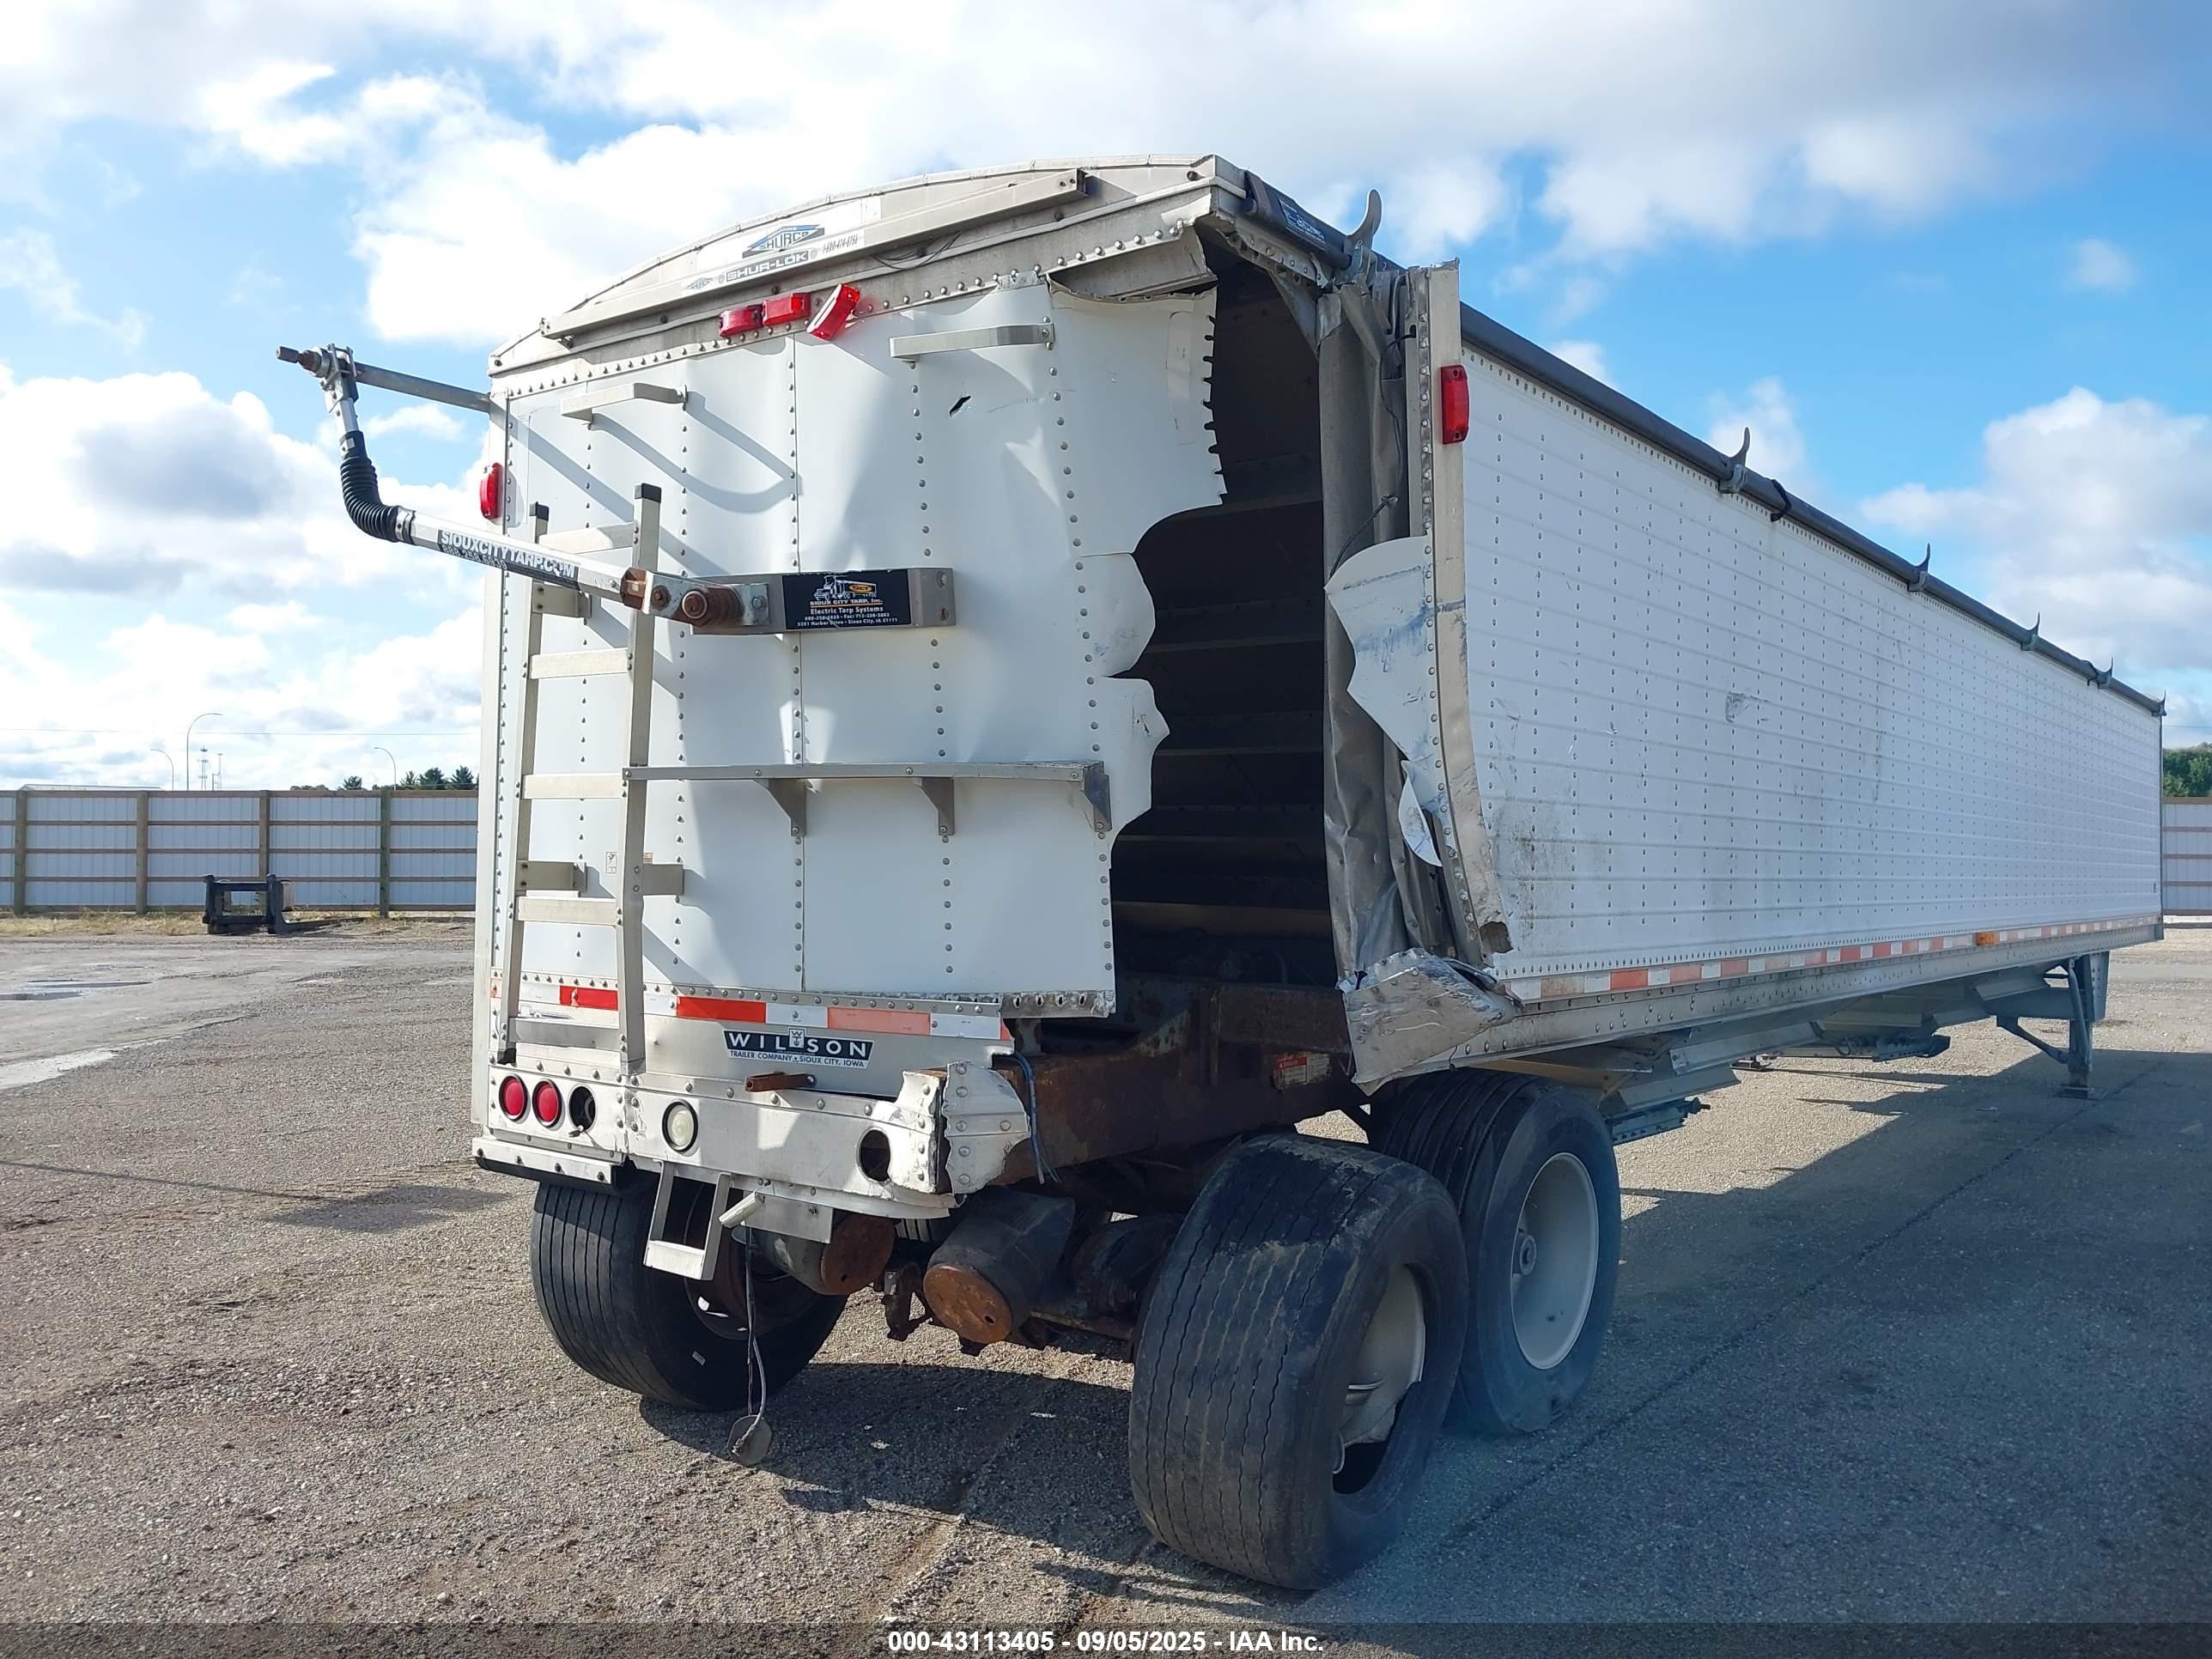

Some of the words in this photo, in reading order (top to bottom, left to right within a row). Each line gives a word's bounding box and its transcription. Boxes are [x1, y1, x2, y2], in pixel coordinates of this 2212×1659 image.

[441, 531, 575, 578] SIOUXCITYTARP.COM
[728, 1032, 866, 1058] WILSON
[730, 1050, 756, 1059] TRAILER
[757, 1053, 793, 1062] COMPANY
[799, 1055, 823, 1065] SIOUX
[823, 1057, 842, 1066] CITY,
[843, 1059, 865, 1067] IOWA
